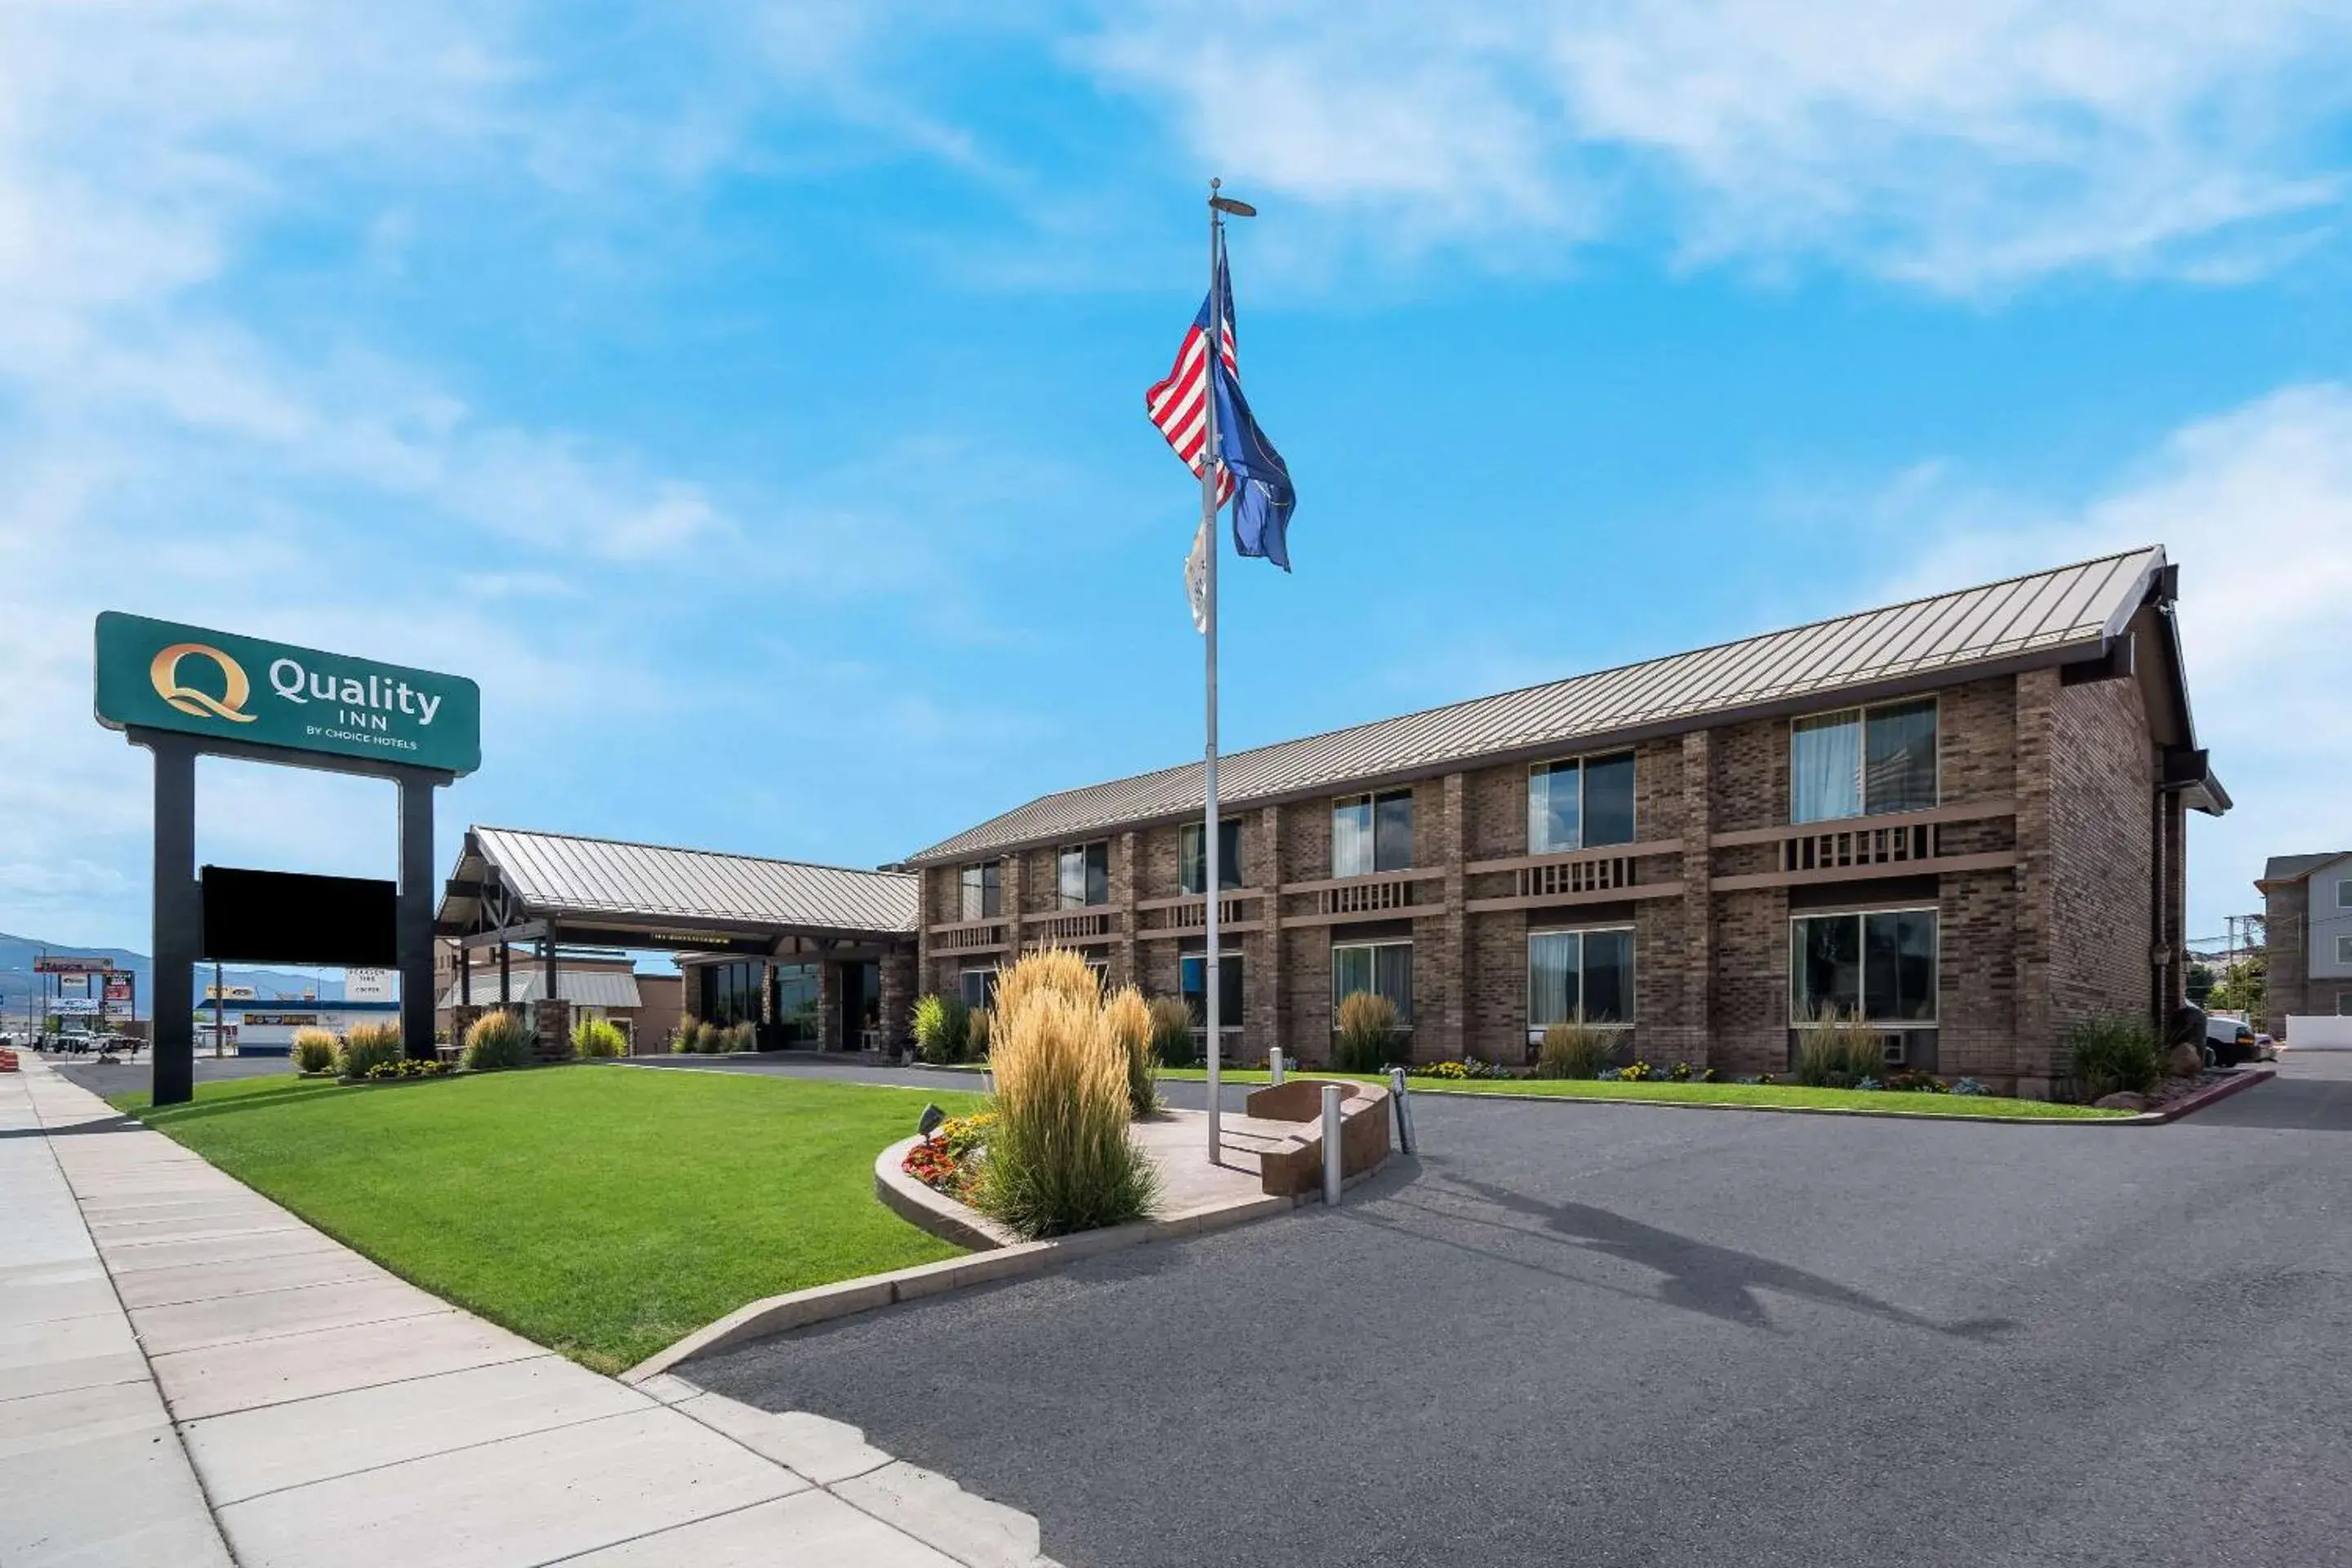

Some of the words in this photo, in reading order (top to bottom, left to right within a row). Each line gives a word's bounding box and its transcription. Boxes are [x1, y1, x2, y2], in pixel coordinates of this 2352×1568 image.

[269, 658, 442, 725] Quality
[339, 710, 387, 731] INN
[306, 725, 321, 735] BY
[325, 728, 370, 743] CHOICE
[373, 737, 417, 751] HOTELS
